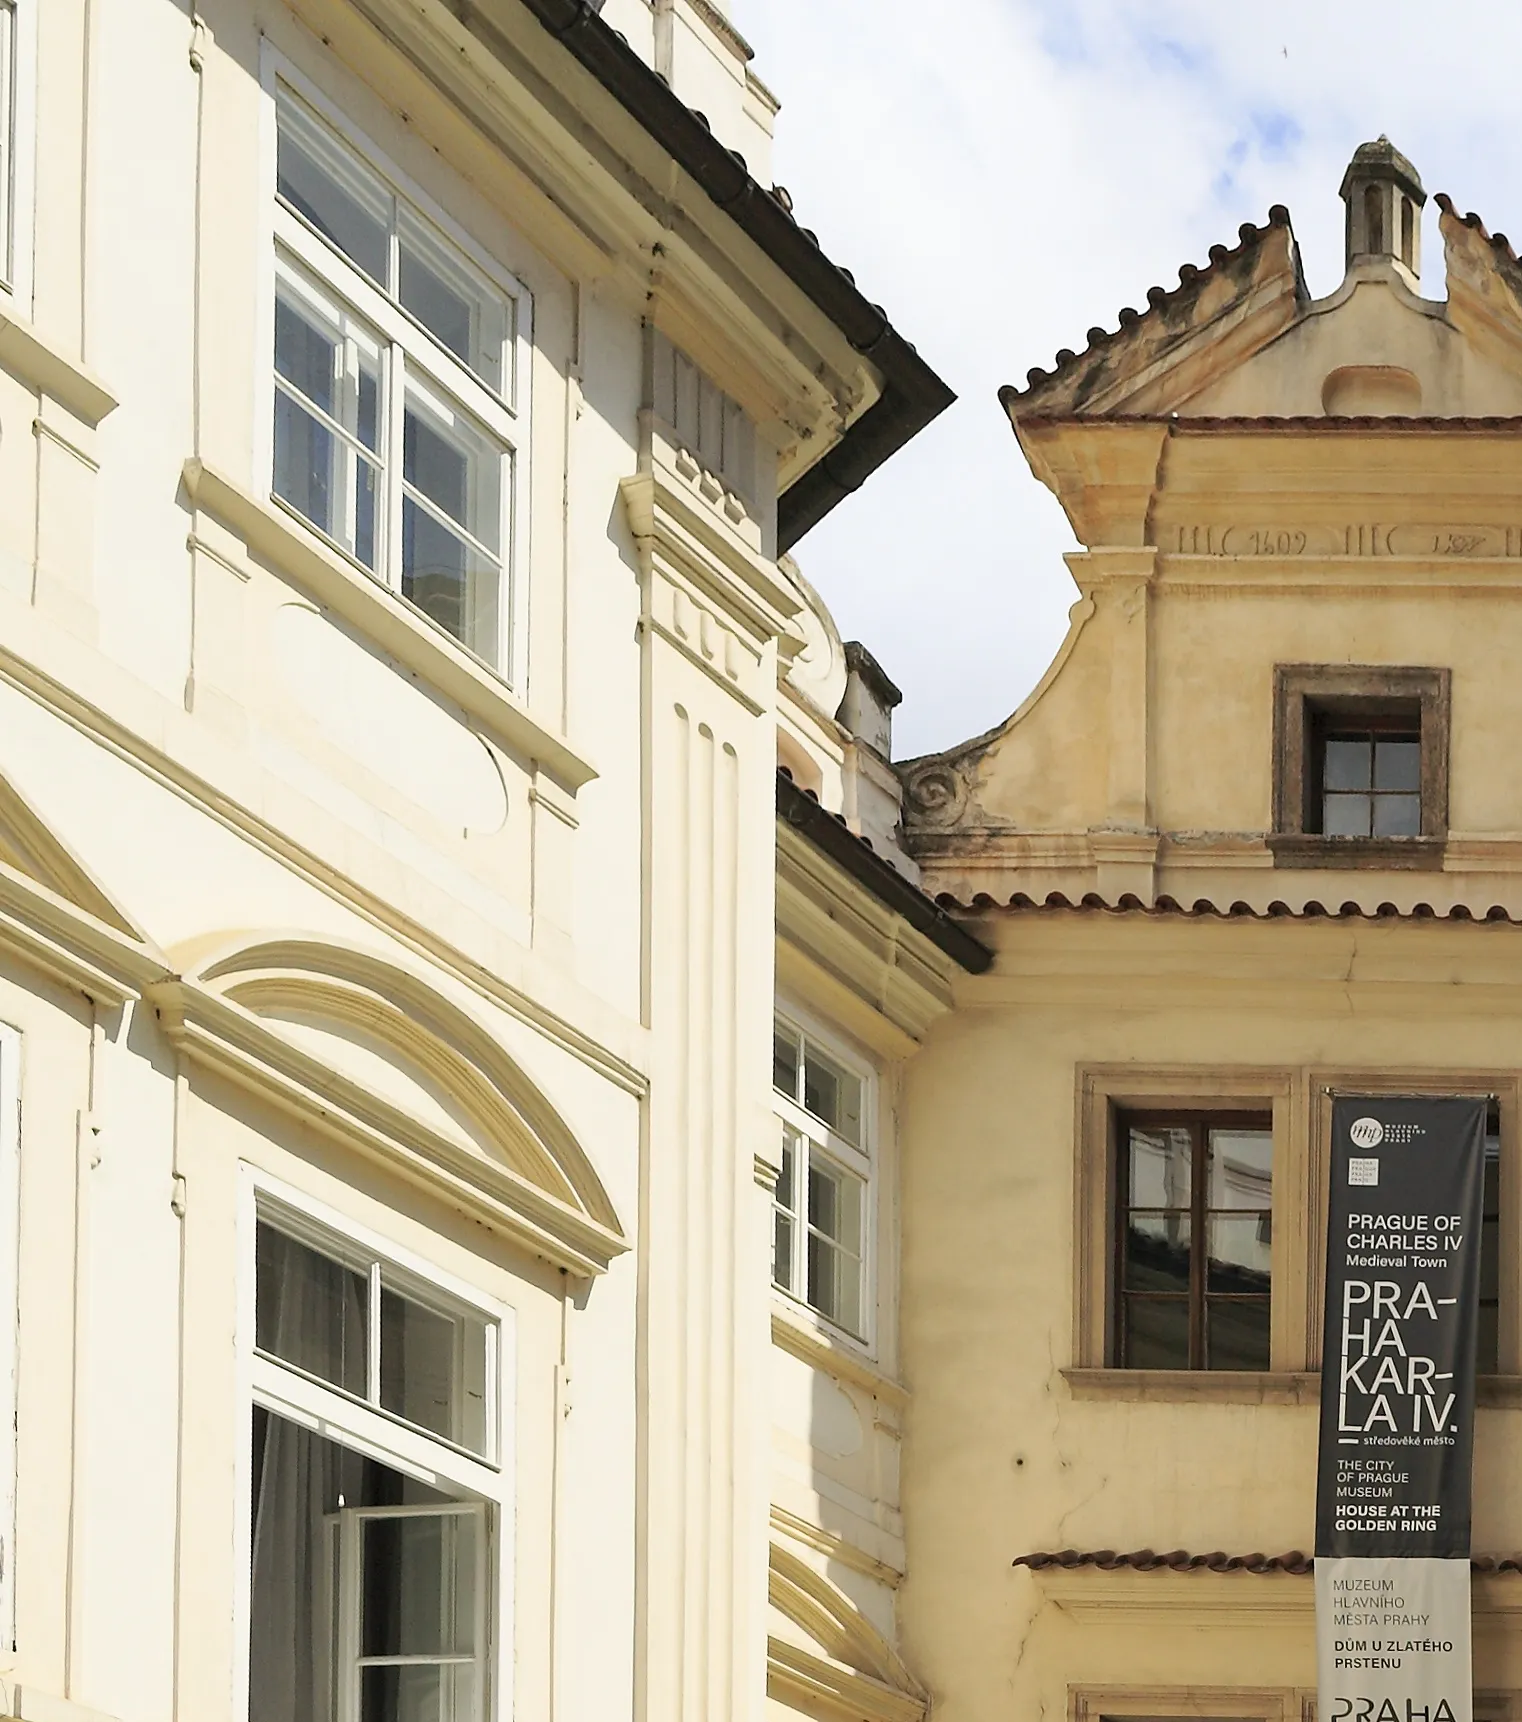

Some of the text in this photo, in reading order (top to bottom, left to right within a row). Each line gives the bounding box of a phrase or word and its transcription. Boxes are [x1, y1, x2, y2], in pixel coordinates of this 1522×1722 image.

[1347, 1213, 1461, 1232] PRAGUE OF
[1346, 1234, 1463, 1251] CHARLES IV
[1345, 1254, 1448, 1268] Medieval Town
[1343, 1280, 1457, 1320] PRA-
[1341, 1318, 1407, 1357] HA
[1340, 1356, 1453, 1395] KAR-
[1338, 1393, 1458, 1432] LA IV.
[1363, 1436, 1455, 1446] středověké město
[1337, 1459, 1394, 1471] THE CITY
[1337, 1472, 1409, 1483] OF PRAGUE
[1336, 1487, 1393, 1498] MUSEUM
[1336, 1505, 1441, 1517] HOUSE AT THE
[1335, 1519, 1437, 1531] GOLDEN RING
[1333, 1579, 1394, 1591] MUZEUM
[1333, 1594, 1405, 1609] HLAVNÍHO
[1334, 1612, 1430, 1626] MĚSTA PRAHY
[1335, 1637, 1453, 1652] DŮM U ZLATÉHO
[1335, 1657, 1401, 1669] PRSTENU
